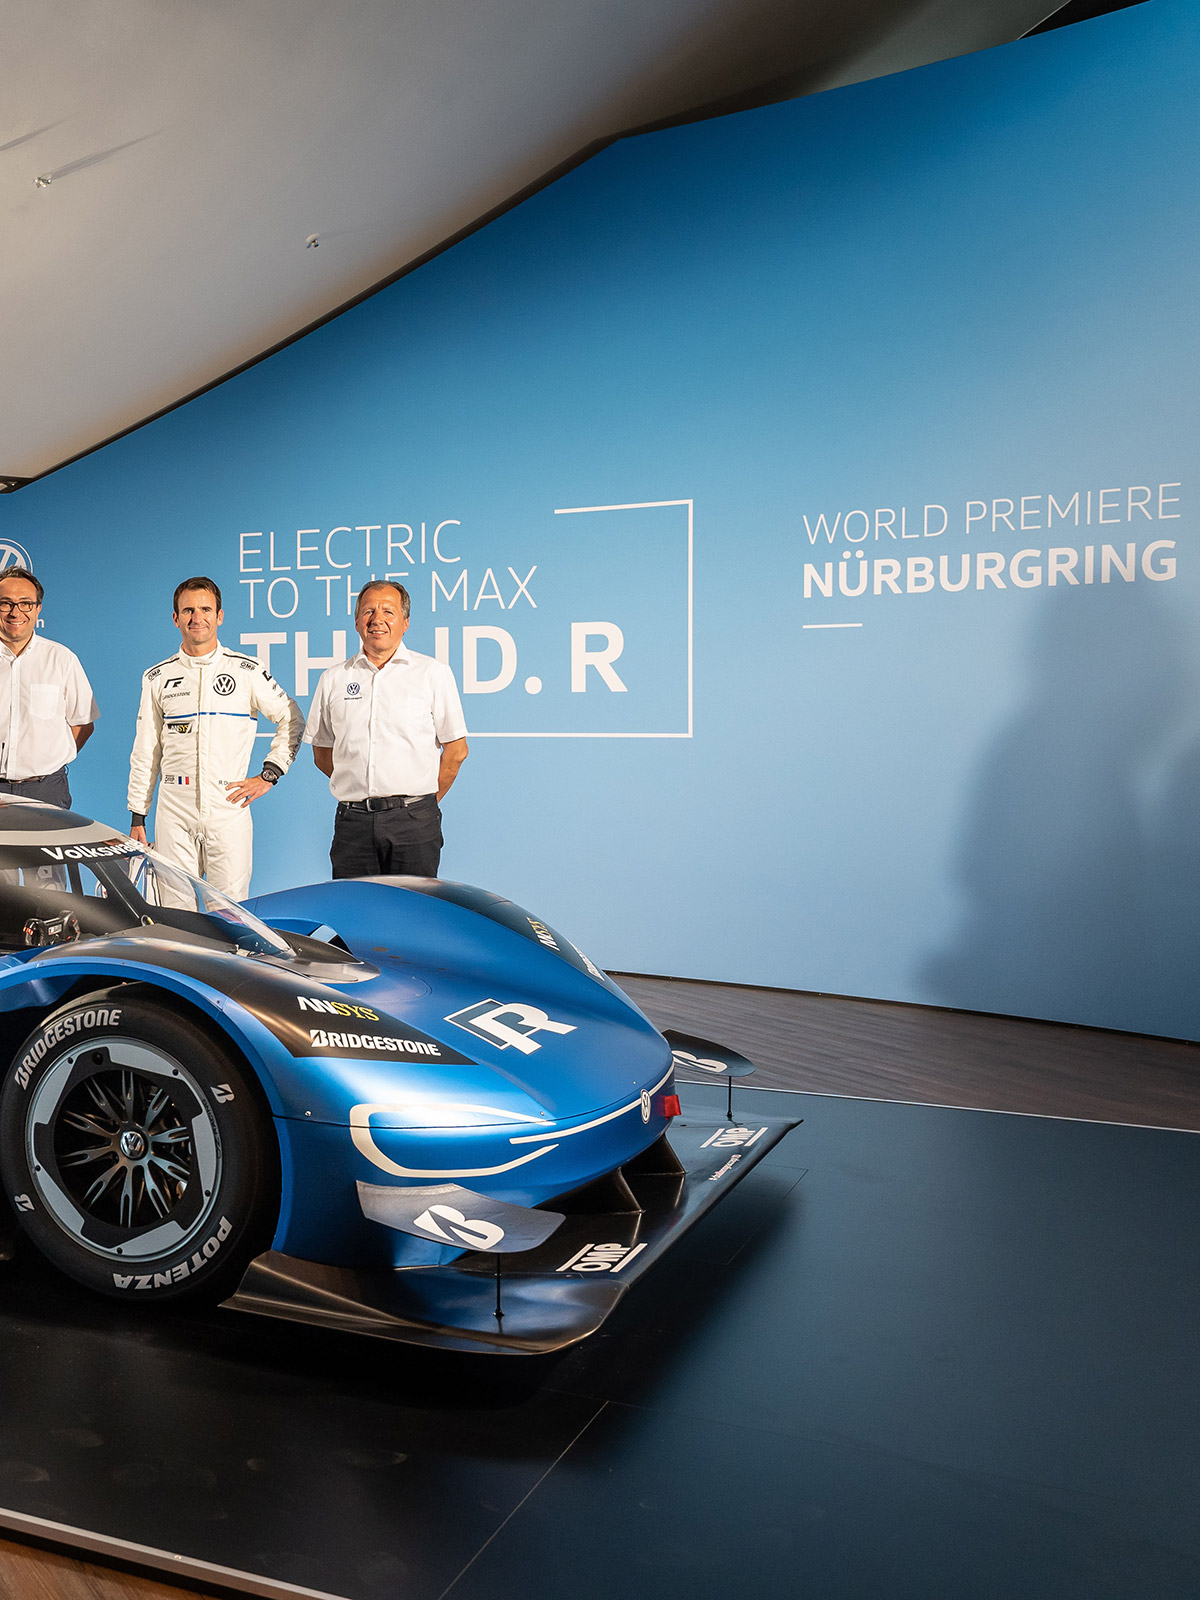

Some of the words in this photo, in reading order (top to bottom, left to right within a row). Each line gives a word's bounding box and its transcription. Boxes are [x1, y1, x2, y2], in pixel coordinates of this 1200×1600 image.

[802, 504, 949, 545] WORLD
[965, 482, 1182, 534] PREMIERE
[239, 519, 462, 572] ELECTRIC
[803, 540, 1178, 599] NÜRBURGRING
[239, 576, 299, 619] TO
[315, 571, 410, 616] TH
[431, 565, 538, 614] MAX
[571, 620, 628, 693] R
[297, 996, 380, 1022] ANSYS
[14, 1009, 122, 1091] BRIDGESTONE
[310, 1029, 442, 1057] BRIDGESTONE
[113, 1216, 233, 1290] POTENZA
